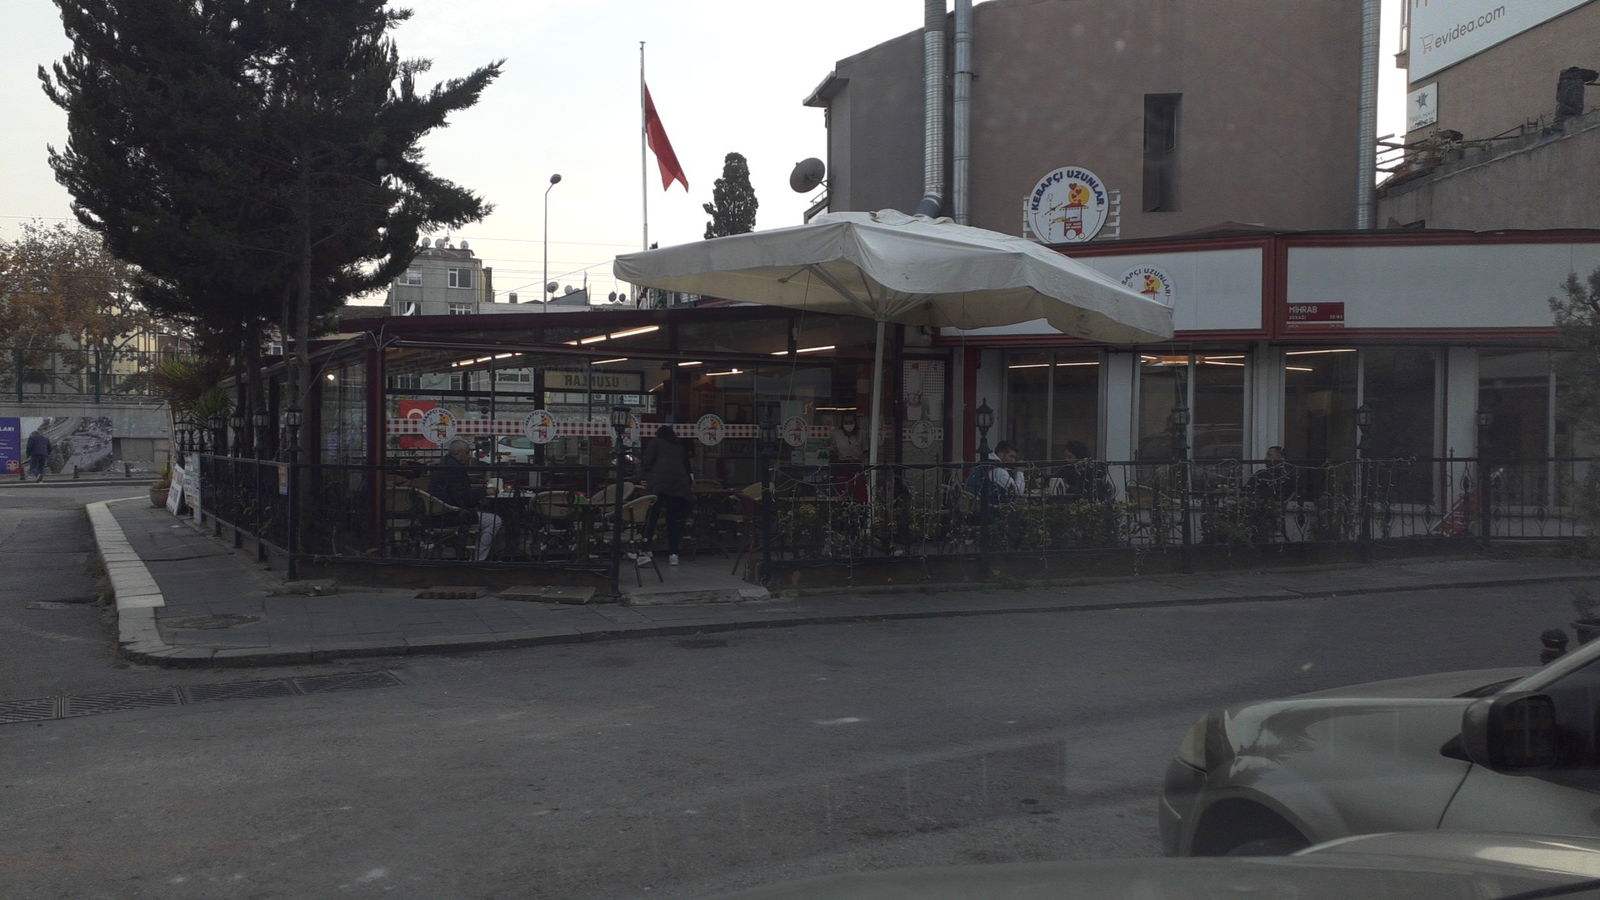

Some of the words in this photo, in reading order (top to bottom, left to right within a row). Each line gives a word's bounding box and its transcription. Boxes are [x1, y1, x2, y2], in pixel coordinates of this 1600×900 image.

[1434, 5, 1505, 49] evidea.com
[1031, 170, 1064, 211] KEBAPÇI
[1066, 169, 1105, 207] UZUNLAR
[1144, 267, 1172, 295] UZUNLAR
